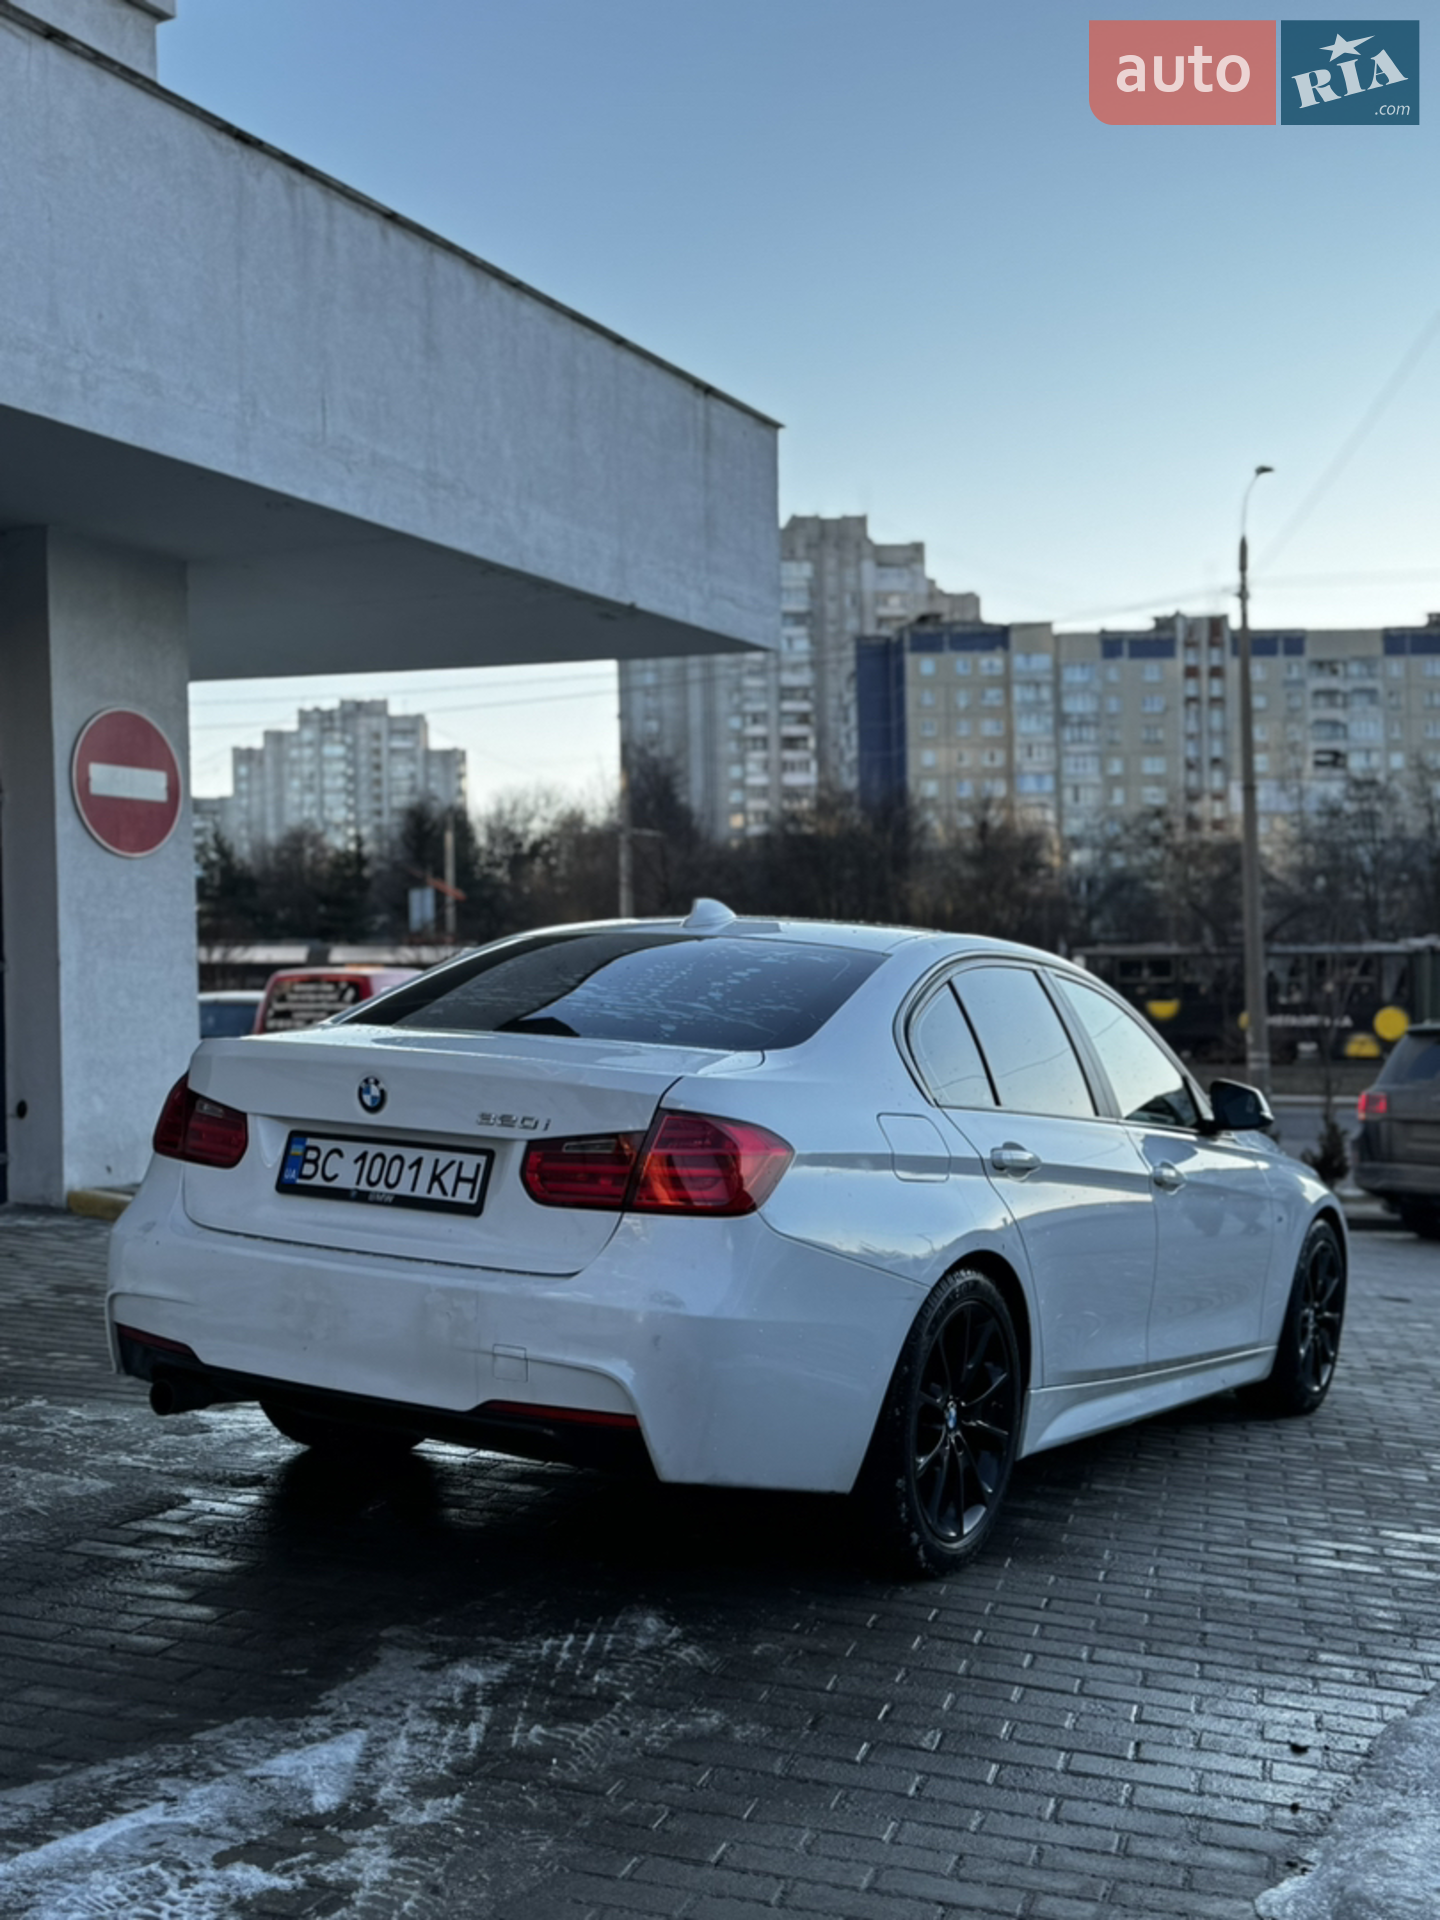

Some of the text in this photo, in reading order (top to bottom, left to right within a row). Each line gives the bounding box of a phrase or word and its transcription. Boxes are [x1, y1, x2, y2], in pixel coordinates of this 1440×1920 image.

[298, 1145, 482, 1200] BC 1001 KH
